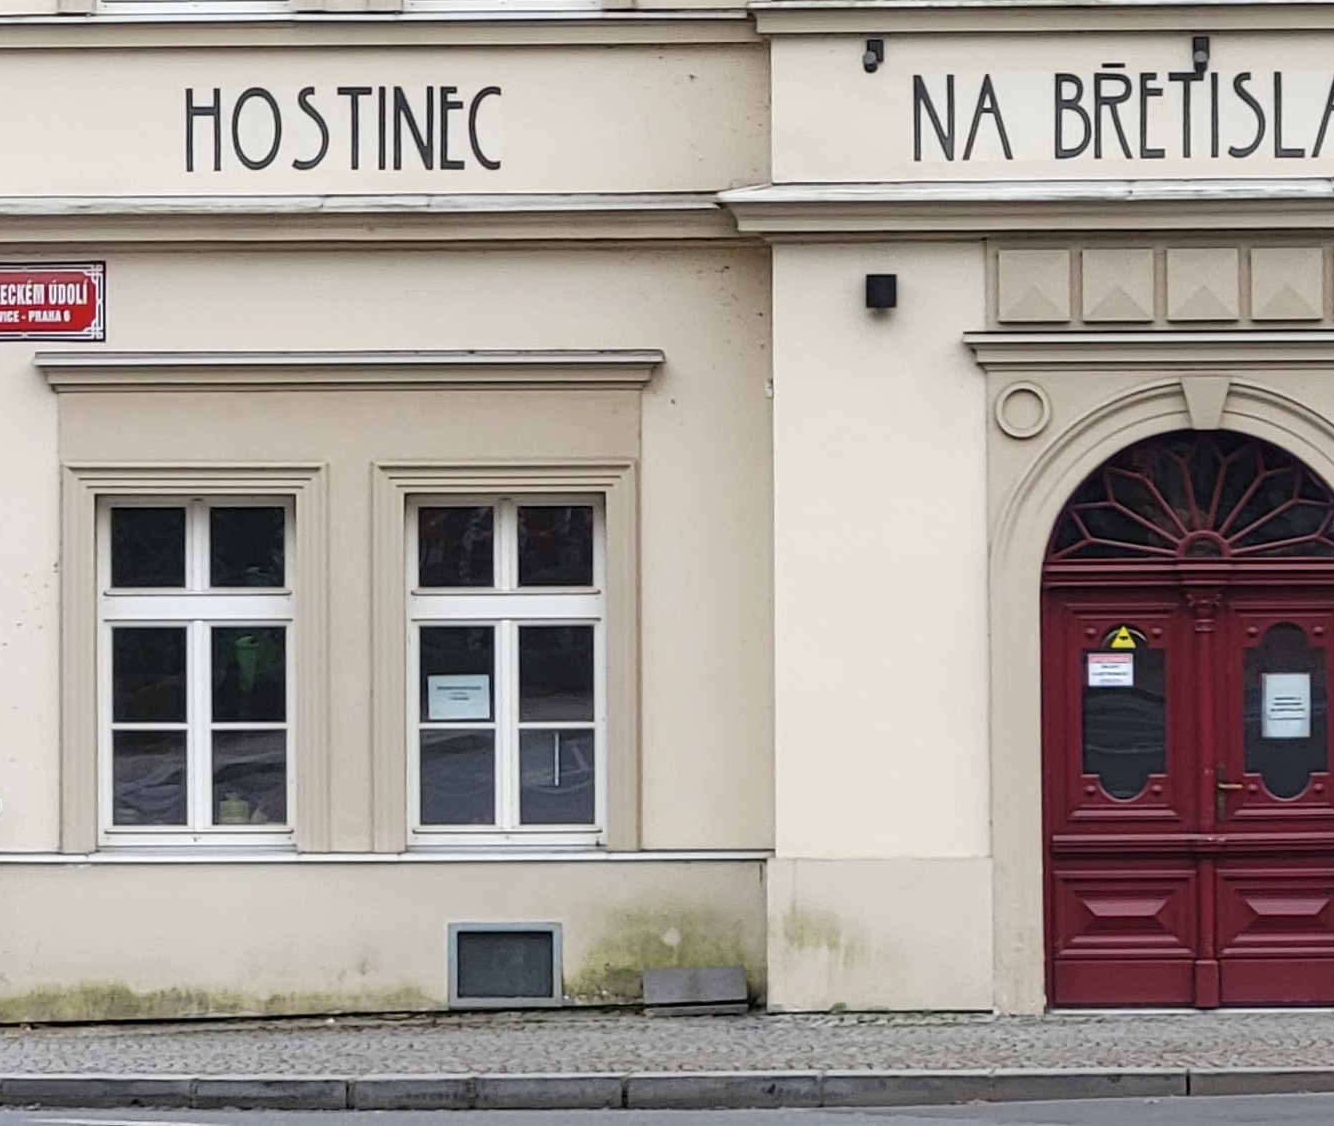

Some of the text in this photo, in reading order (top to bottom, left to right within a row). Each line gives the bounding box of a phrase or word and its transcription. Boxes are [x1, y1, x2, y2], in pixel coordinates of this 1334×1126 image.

[185, 85, 502, 172] HOSTINEC
[913, 73, 1013, 162] NA
[28, 310, 62, 323] PRAHA
[48, 279, 88, 306] ÚDOLÍ
